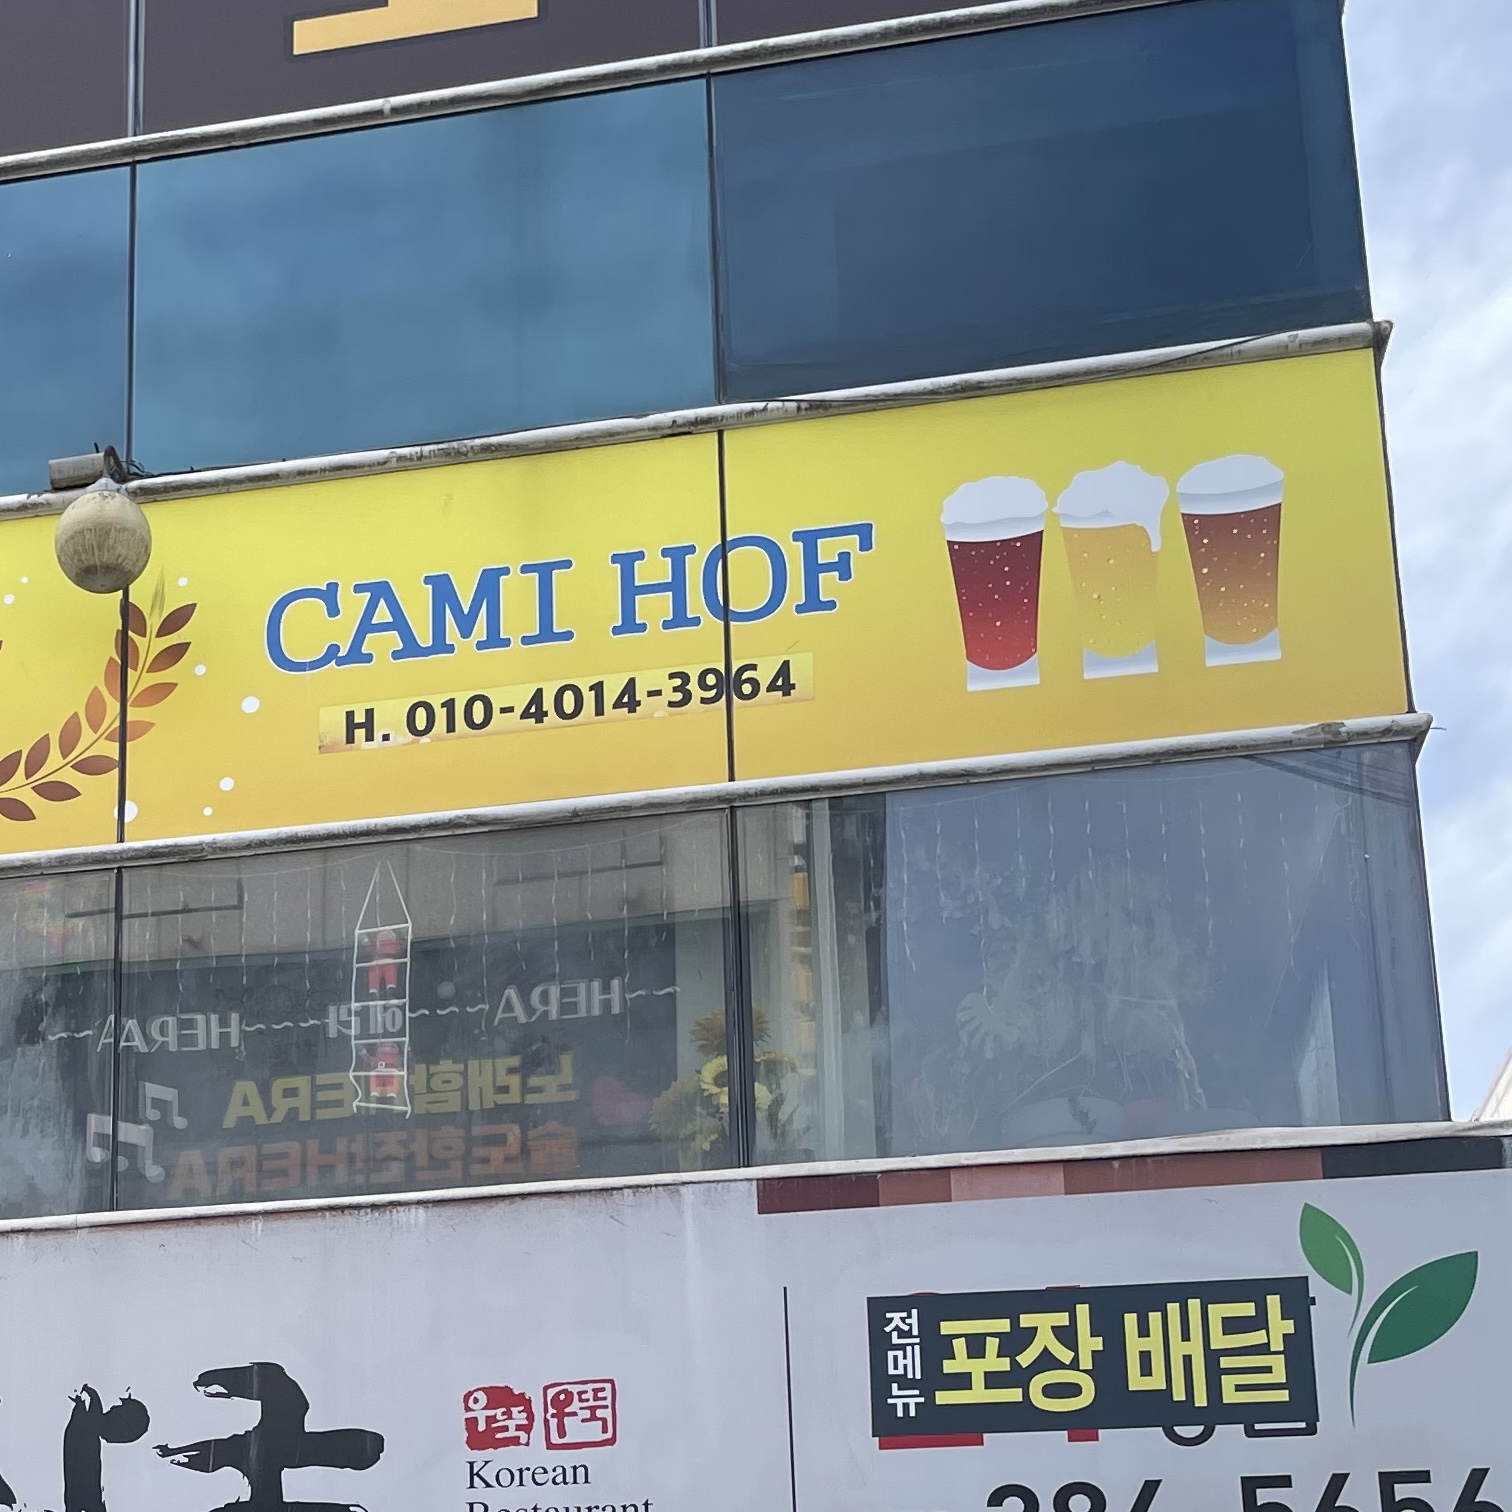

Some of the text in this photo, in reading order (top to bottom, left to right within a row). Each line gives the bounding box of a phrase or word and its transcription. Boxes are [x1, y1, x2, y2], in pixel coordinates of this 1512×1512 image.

[267, 522, 876, 674] CAMI HOF
[343, 659, 796, 747] H. 010-4014-3964
[883, 1307, 925, 1418] 전메뉴
[934, 1294, 1296, 1413] 포장 배달
[466, 1459, 591, 1490] Korean
